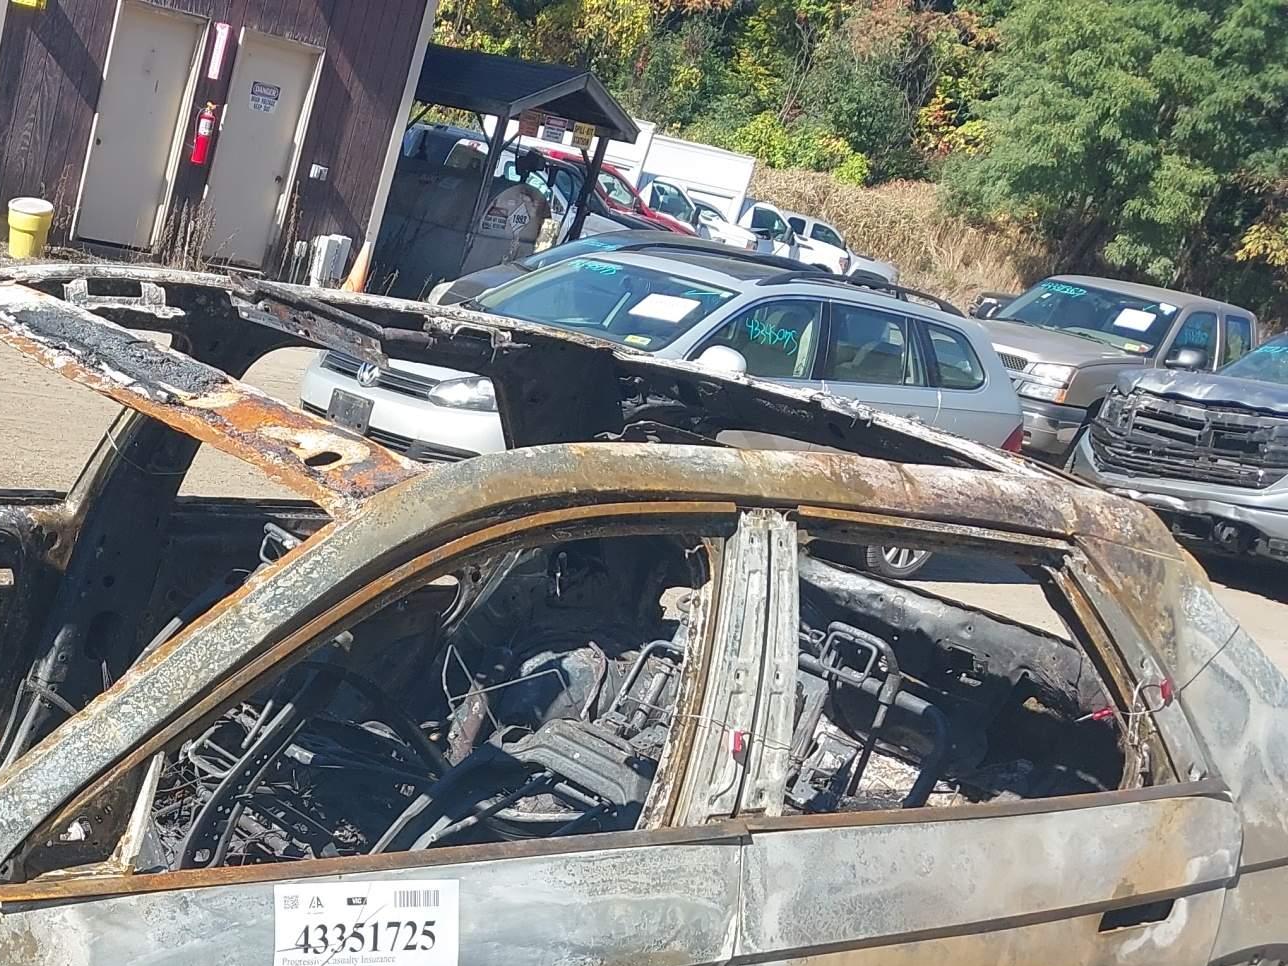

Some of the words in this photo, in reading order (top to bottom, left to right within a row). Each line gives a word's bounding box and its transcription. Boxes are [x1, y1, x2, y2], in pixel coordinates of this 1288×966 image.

[255, 85, 277, 96] DANGER
[295, 920, 436, 954] 43351725
[361, 955, 396, 964] Insurance
